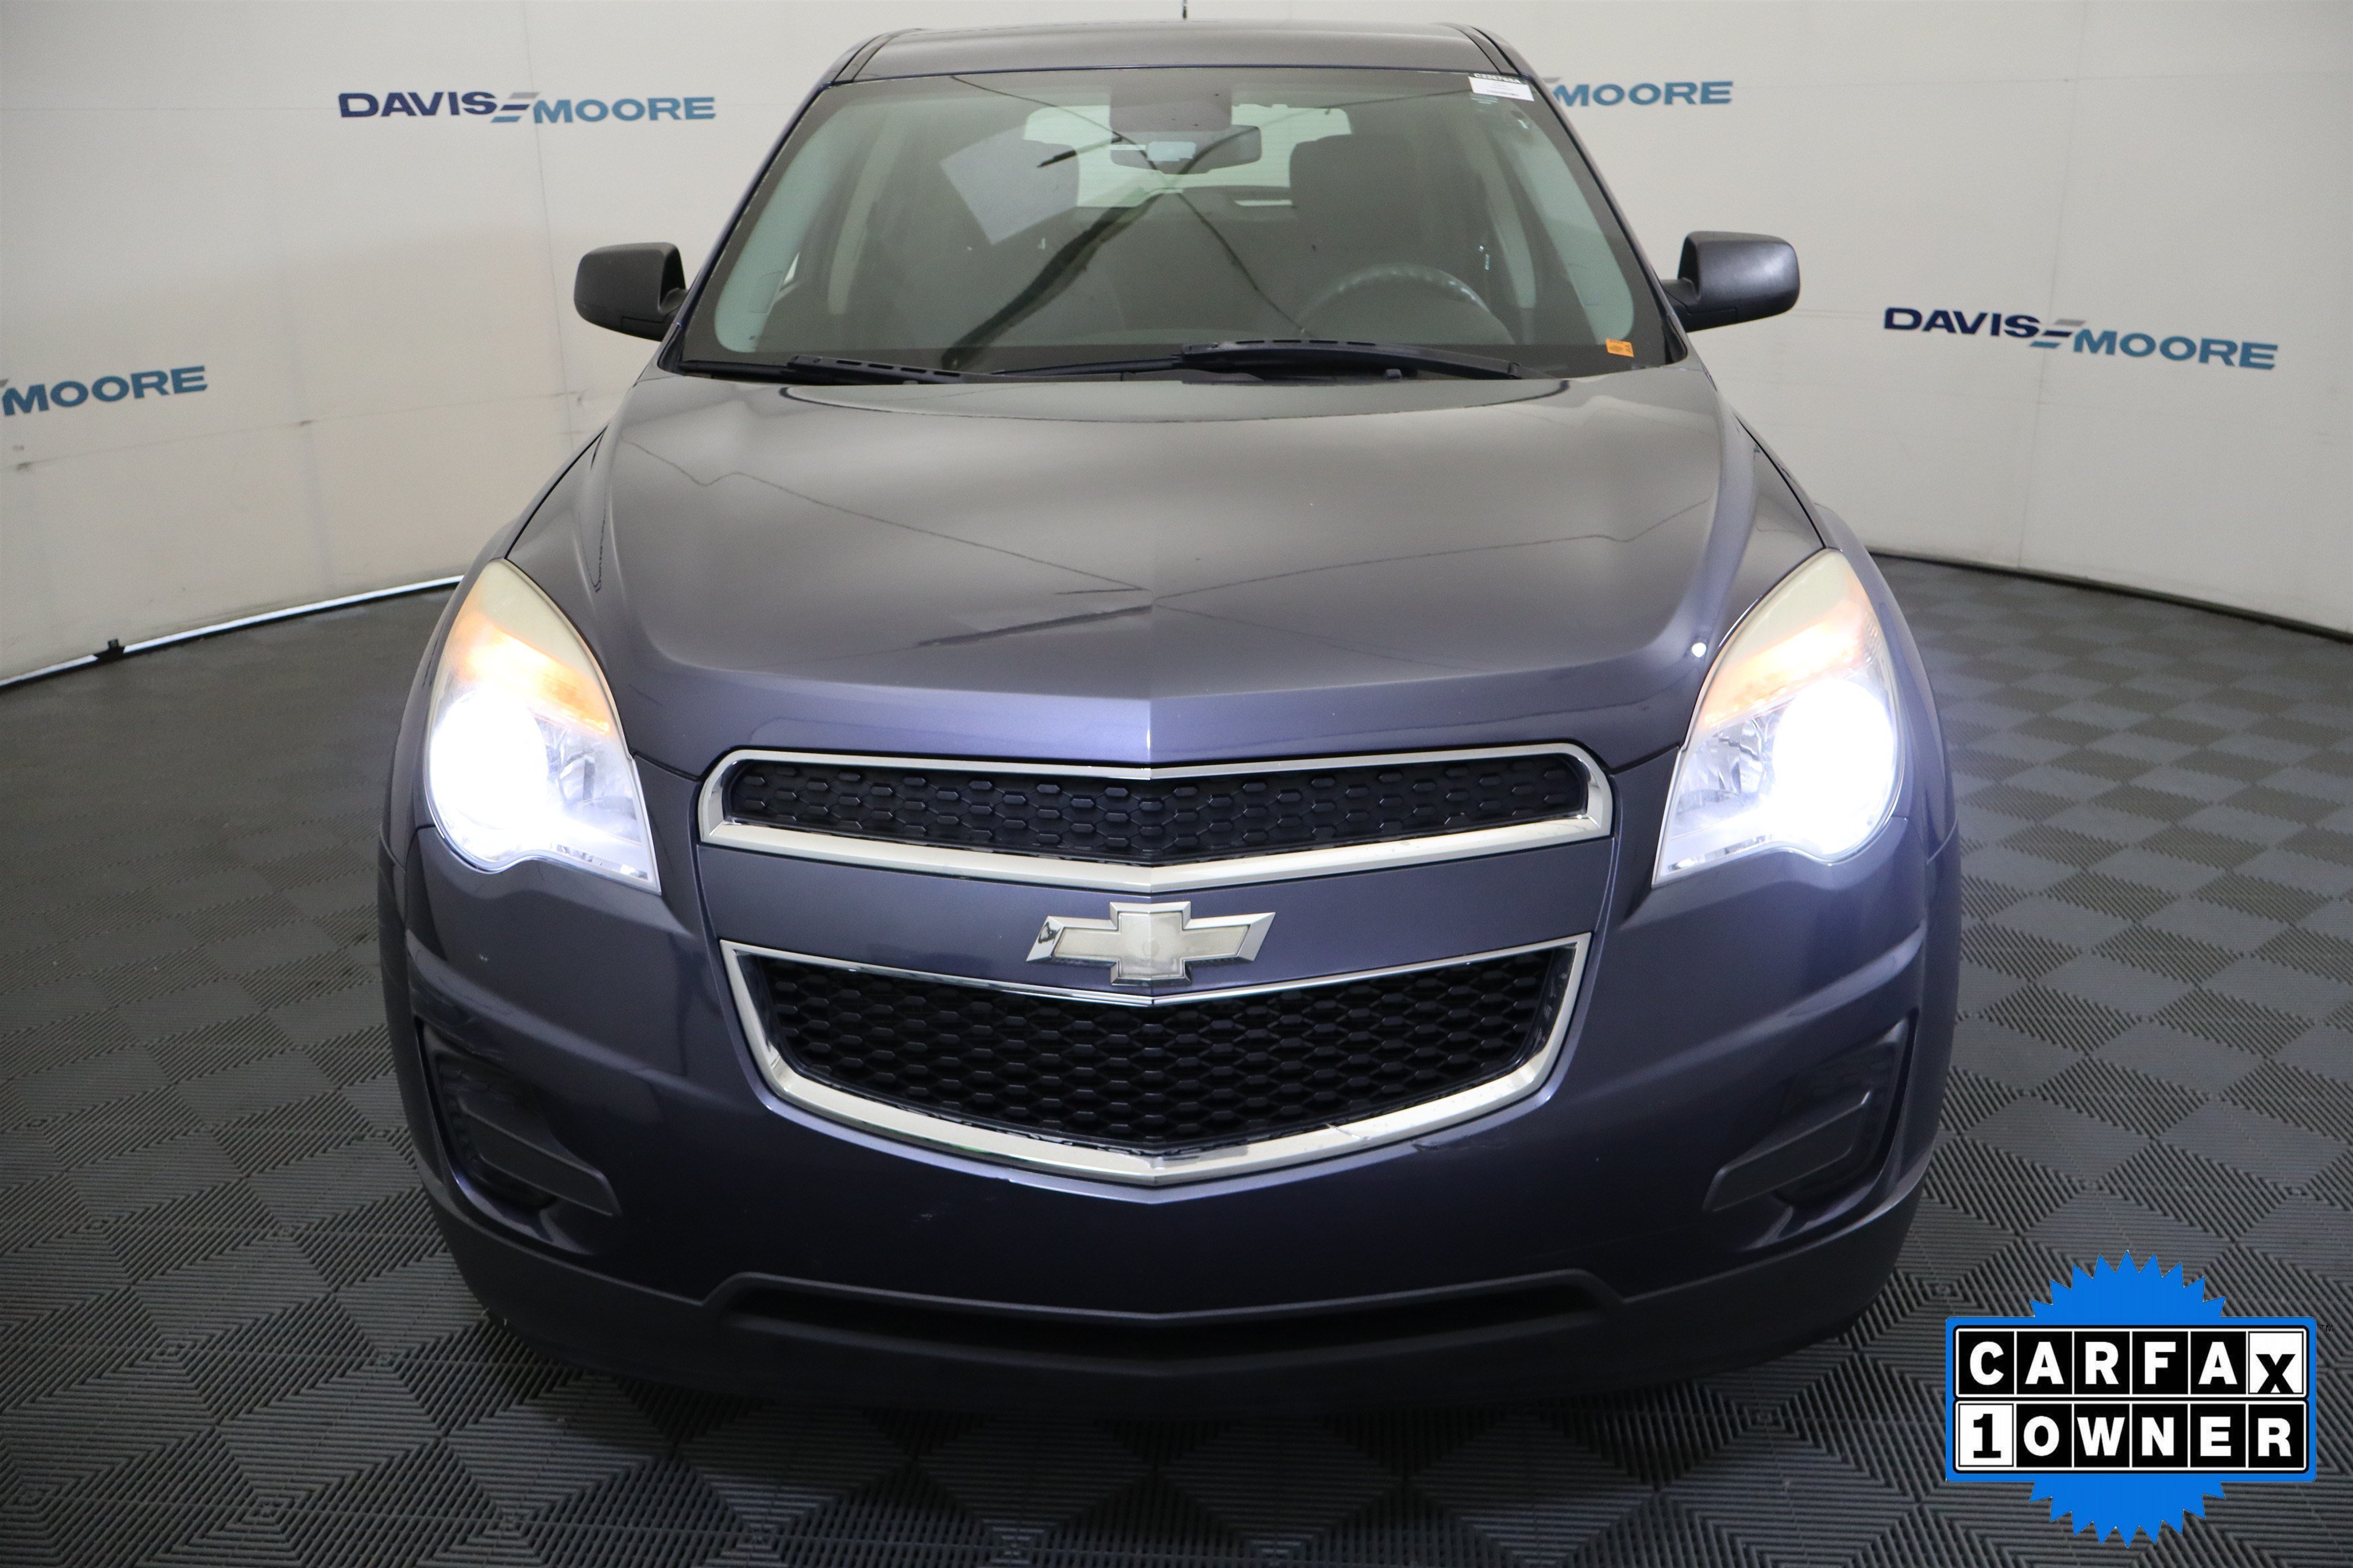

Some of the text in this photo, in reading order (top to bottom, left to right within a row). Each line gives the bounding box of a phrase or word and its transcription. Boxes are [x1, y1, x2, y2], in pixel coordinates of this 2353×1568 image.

[338, 91, 716, 124] DAVIS MOORE
[1553, 81, 1733, 107] MOORE
[1883, 307, 2279, 370] DAVIS MOORE
[1, 365, 209, 418] MOORE
